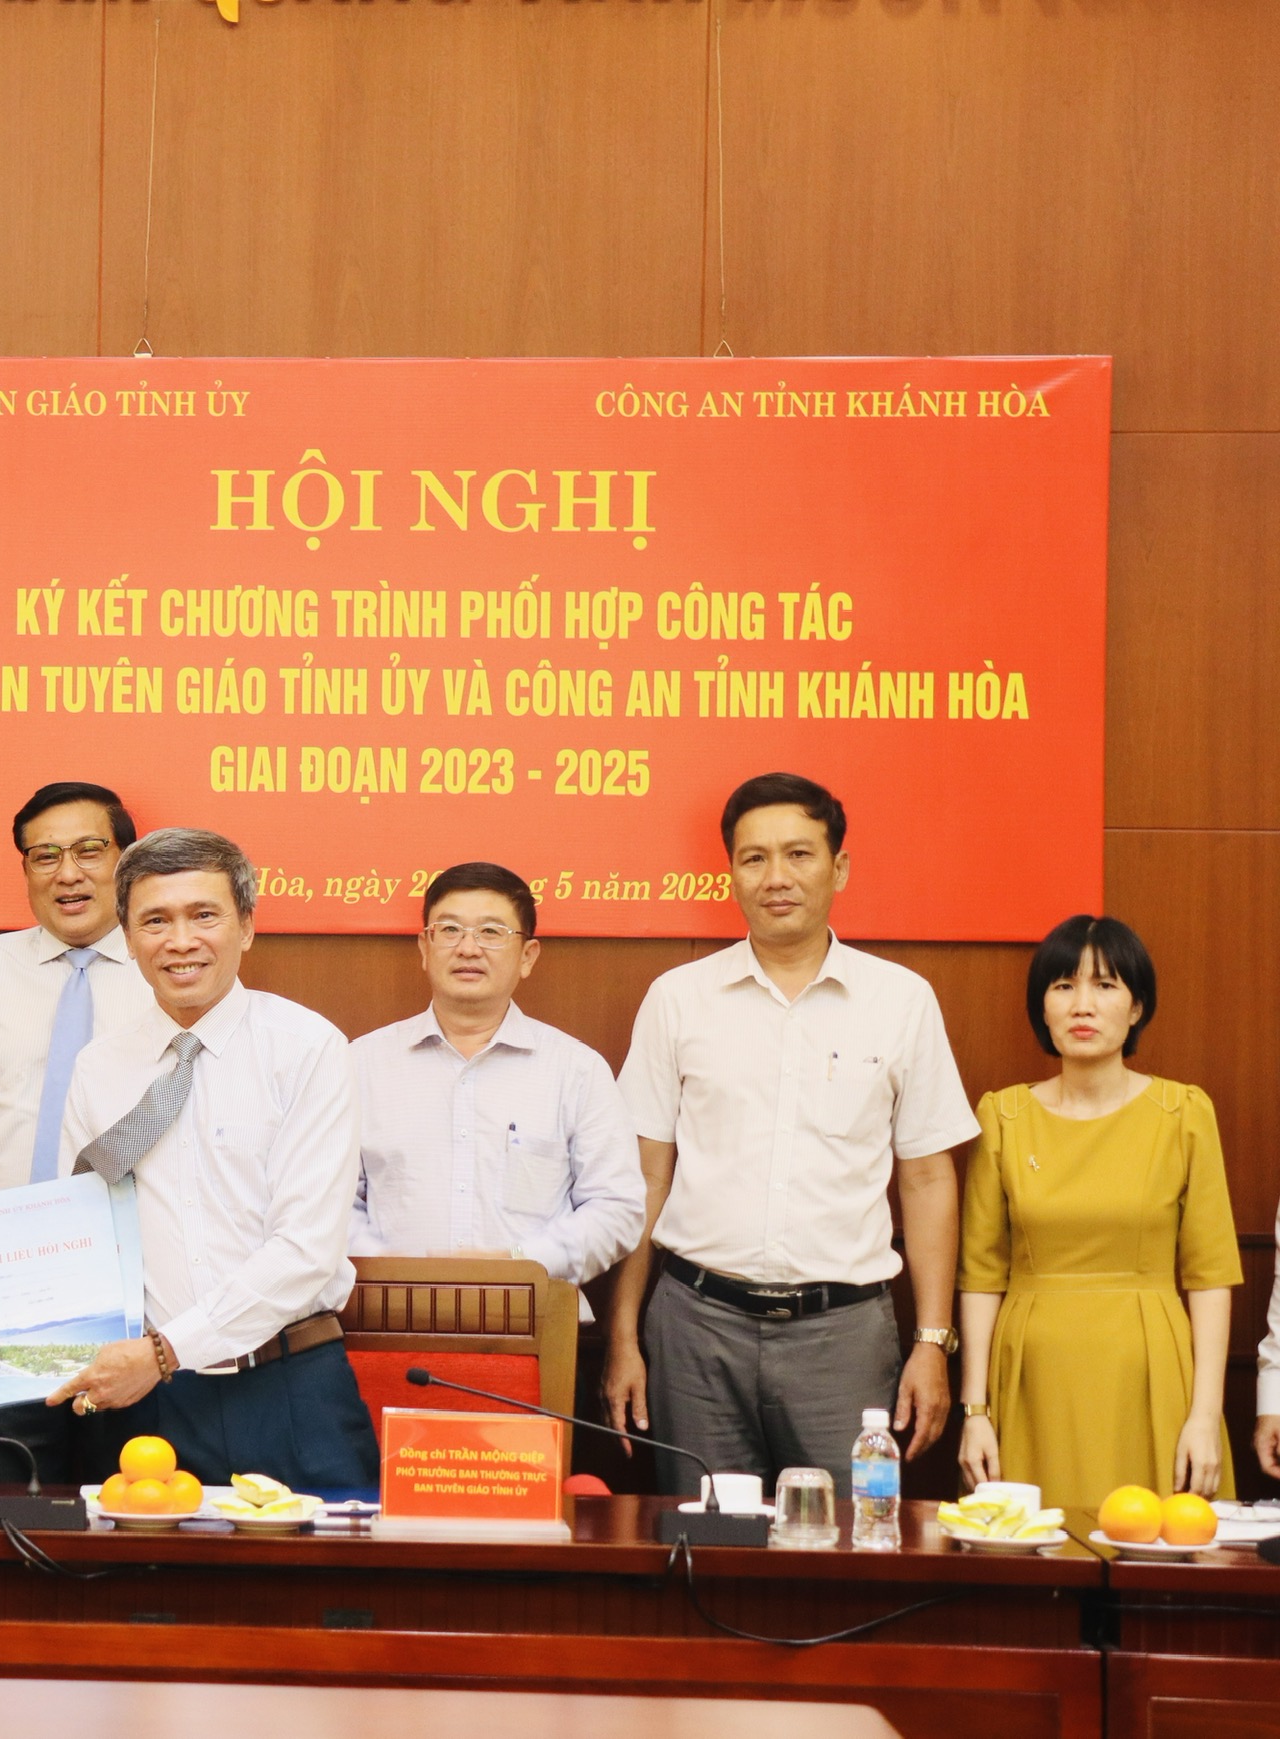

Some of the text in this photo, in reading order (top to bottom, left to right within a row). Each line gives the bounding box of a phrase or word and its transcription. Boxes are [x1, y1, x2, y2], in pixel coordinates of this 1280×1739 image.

[26, 383, 107, 417] GIÁO
[115, 380, 196, 417] TỈNH
[206, 380, 250, 417] ỦY
[595, 380, 1052, 418] CÔNG AN TỈNH KHÁNH HÒA
[209, 448, 657, 551] HỘI NGHỊ
[16, 573, 853, 650] KÝ KẾT CHƯƠNG TRÌNH PHỐI HỢP CÔNG TÁC
[40, 656, 163, 714] TUYÊN
[176, 657, 267, 715] GIÁO
[278, 652, 368, 715] TỈNH
[381, 653, 431, 716] ỦY
[442, 658, 493, 716] VÀ
[505, 660, 613, 718] CÔNG
[625, 670, 681, 718] AN
[693, 654, 784, 718] TỈNH
[798, 661, 934, 719] KHÁNH
[948, 660, 1029, 720] HÒA
[210, 745, 650, 805] GIAI ĐOẠN 2023 - 2025
[322, 868, 402, 905] ngày
[554, 870, 575, 900] 5
[580, 871, 651, 901] năm
[658, 872, 732, 902] 2023
[399, 1447, 428, 1461] Đồng
[430, 1447, 446, 1460] chí
[449, 1446, 479, 1460] TRẦN
[414, 1483, 433, 1493] BAN
[459, 1469, 478, 1479] BAN
